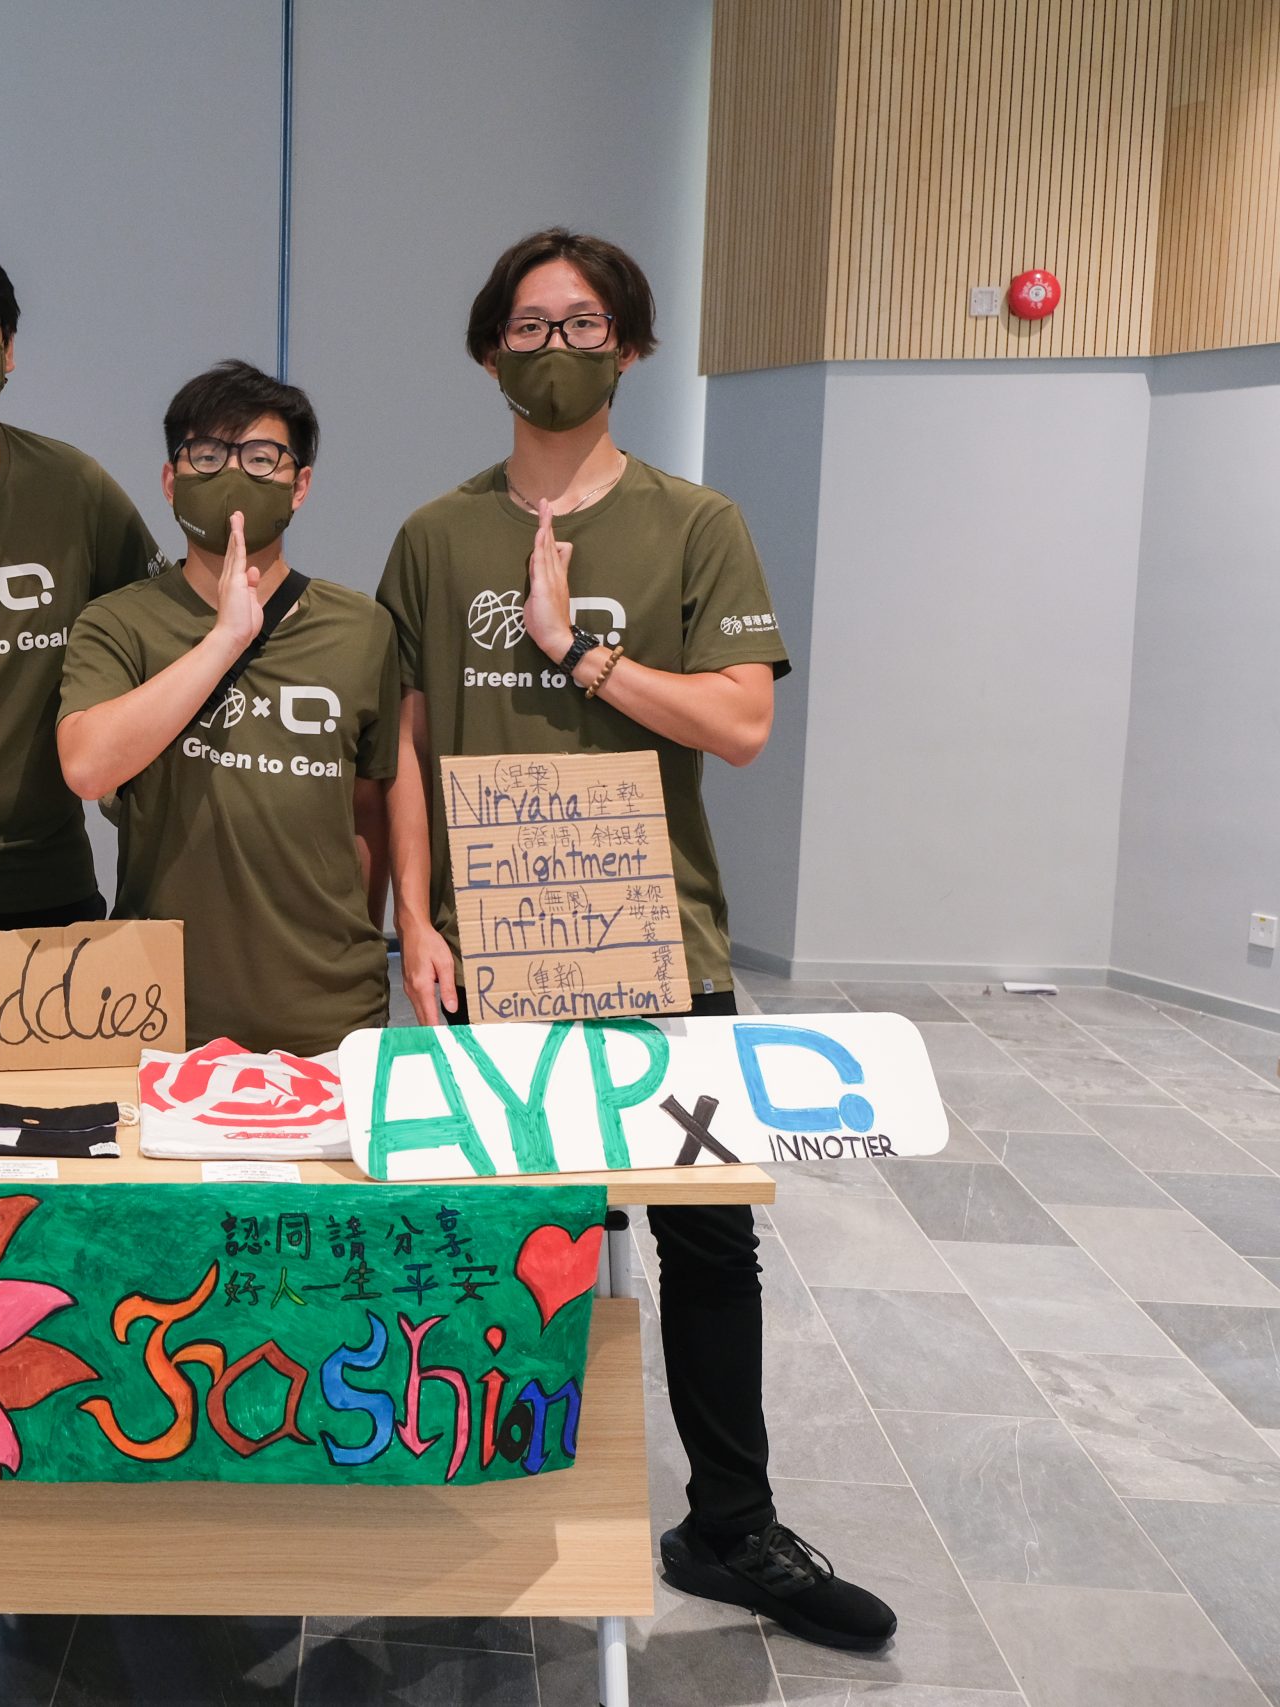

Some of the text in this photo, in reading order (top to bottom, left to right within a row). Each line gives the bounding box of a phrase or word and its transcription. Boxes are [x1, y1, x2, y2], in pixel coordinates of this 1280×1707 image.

[17, 626, 68, 651] Goal
[463, 666, 533, 688] Green
[540, 668, 567, 689] to
[182, 736, 343, 778] Green to Goal
[449, 770, 582, 824] Nirvana
[466, 840, 648, 886] Enlightment
[479, 896, 625, 952] Infinity
[477, 965, 660, 1021] Reincarnation
[368, 1017, 671, 1181] AYP
[767, 1133, 899, 1162] INNOTIER
[222, 1253, 501, 1308] 好人一生平安
